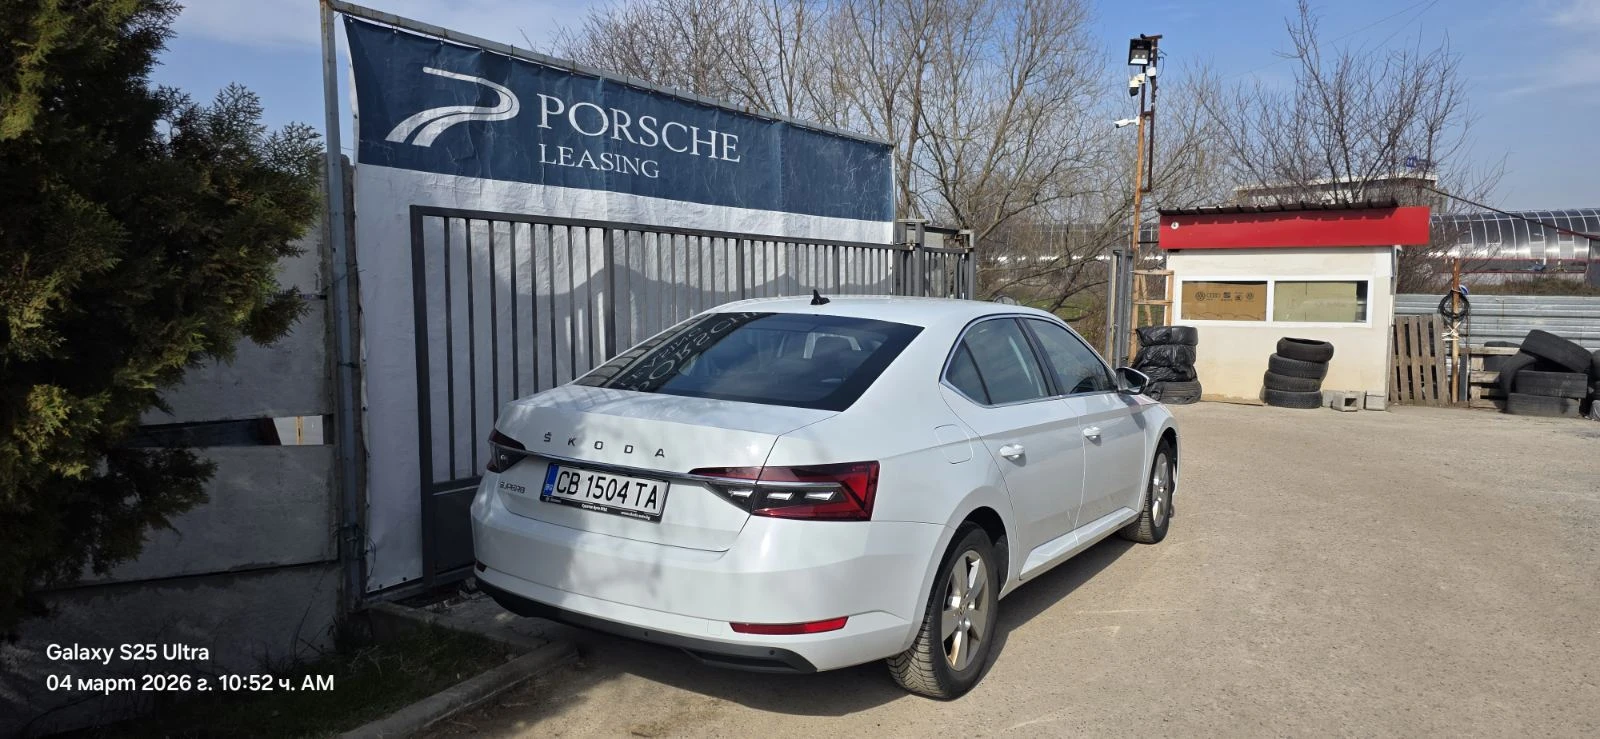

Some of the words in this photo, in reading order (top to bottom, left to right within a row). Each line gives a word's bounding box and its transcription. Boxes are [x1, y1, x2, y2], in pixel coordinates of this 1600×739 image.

[537, 93, 741, 163] PORSCHE
[538, 143, 660, 179] LEASING
[499, 481, 526, 494] SUPERB
[556, 470, 581, 495] CB
[586, 474, 630, 505] 1504
[635, 482, 659, 510] TA
